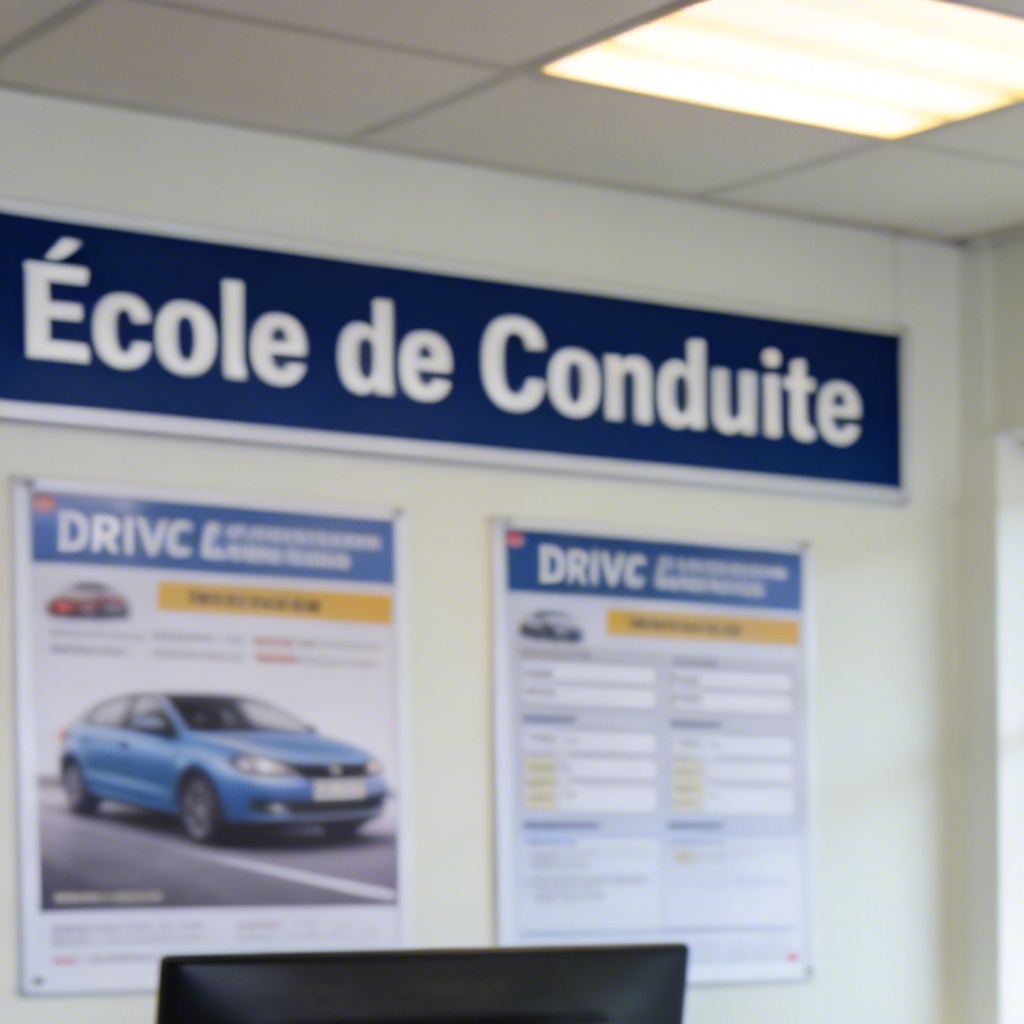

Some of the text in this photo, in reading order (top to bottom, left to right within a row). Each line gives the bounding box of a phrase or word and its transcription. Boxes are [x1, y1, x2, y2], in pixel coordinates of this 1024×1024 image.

[23, 238, 864, 448] École de Conduite
